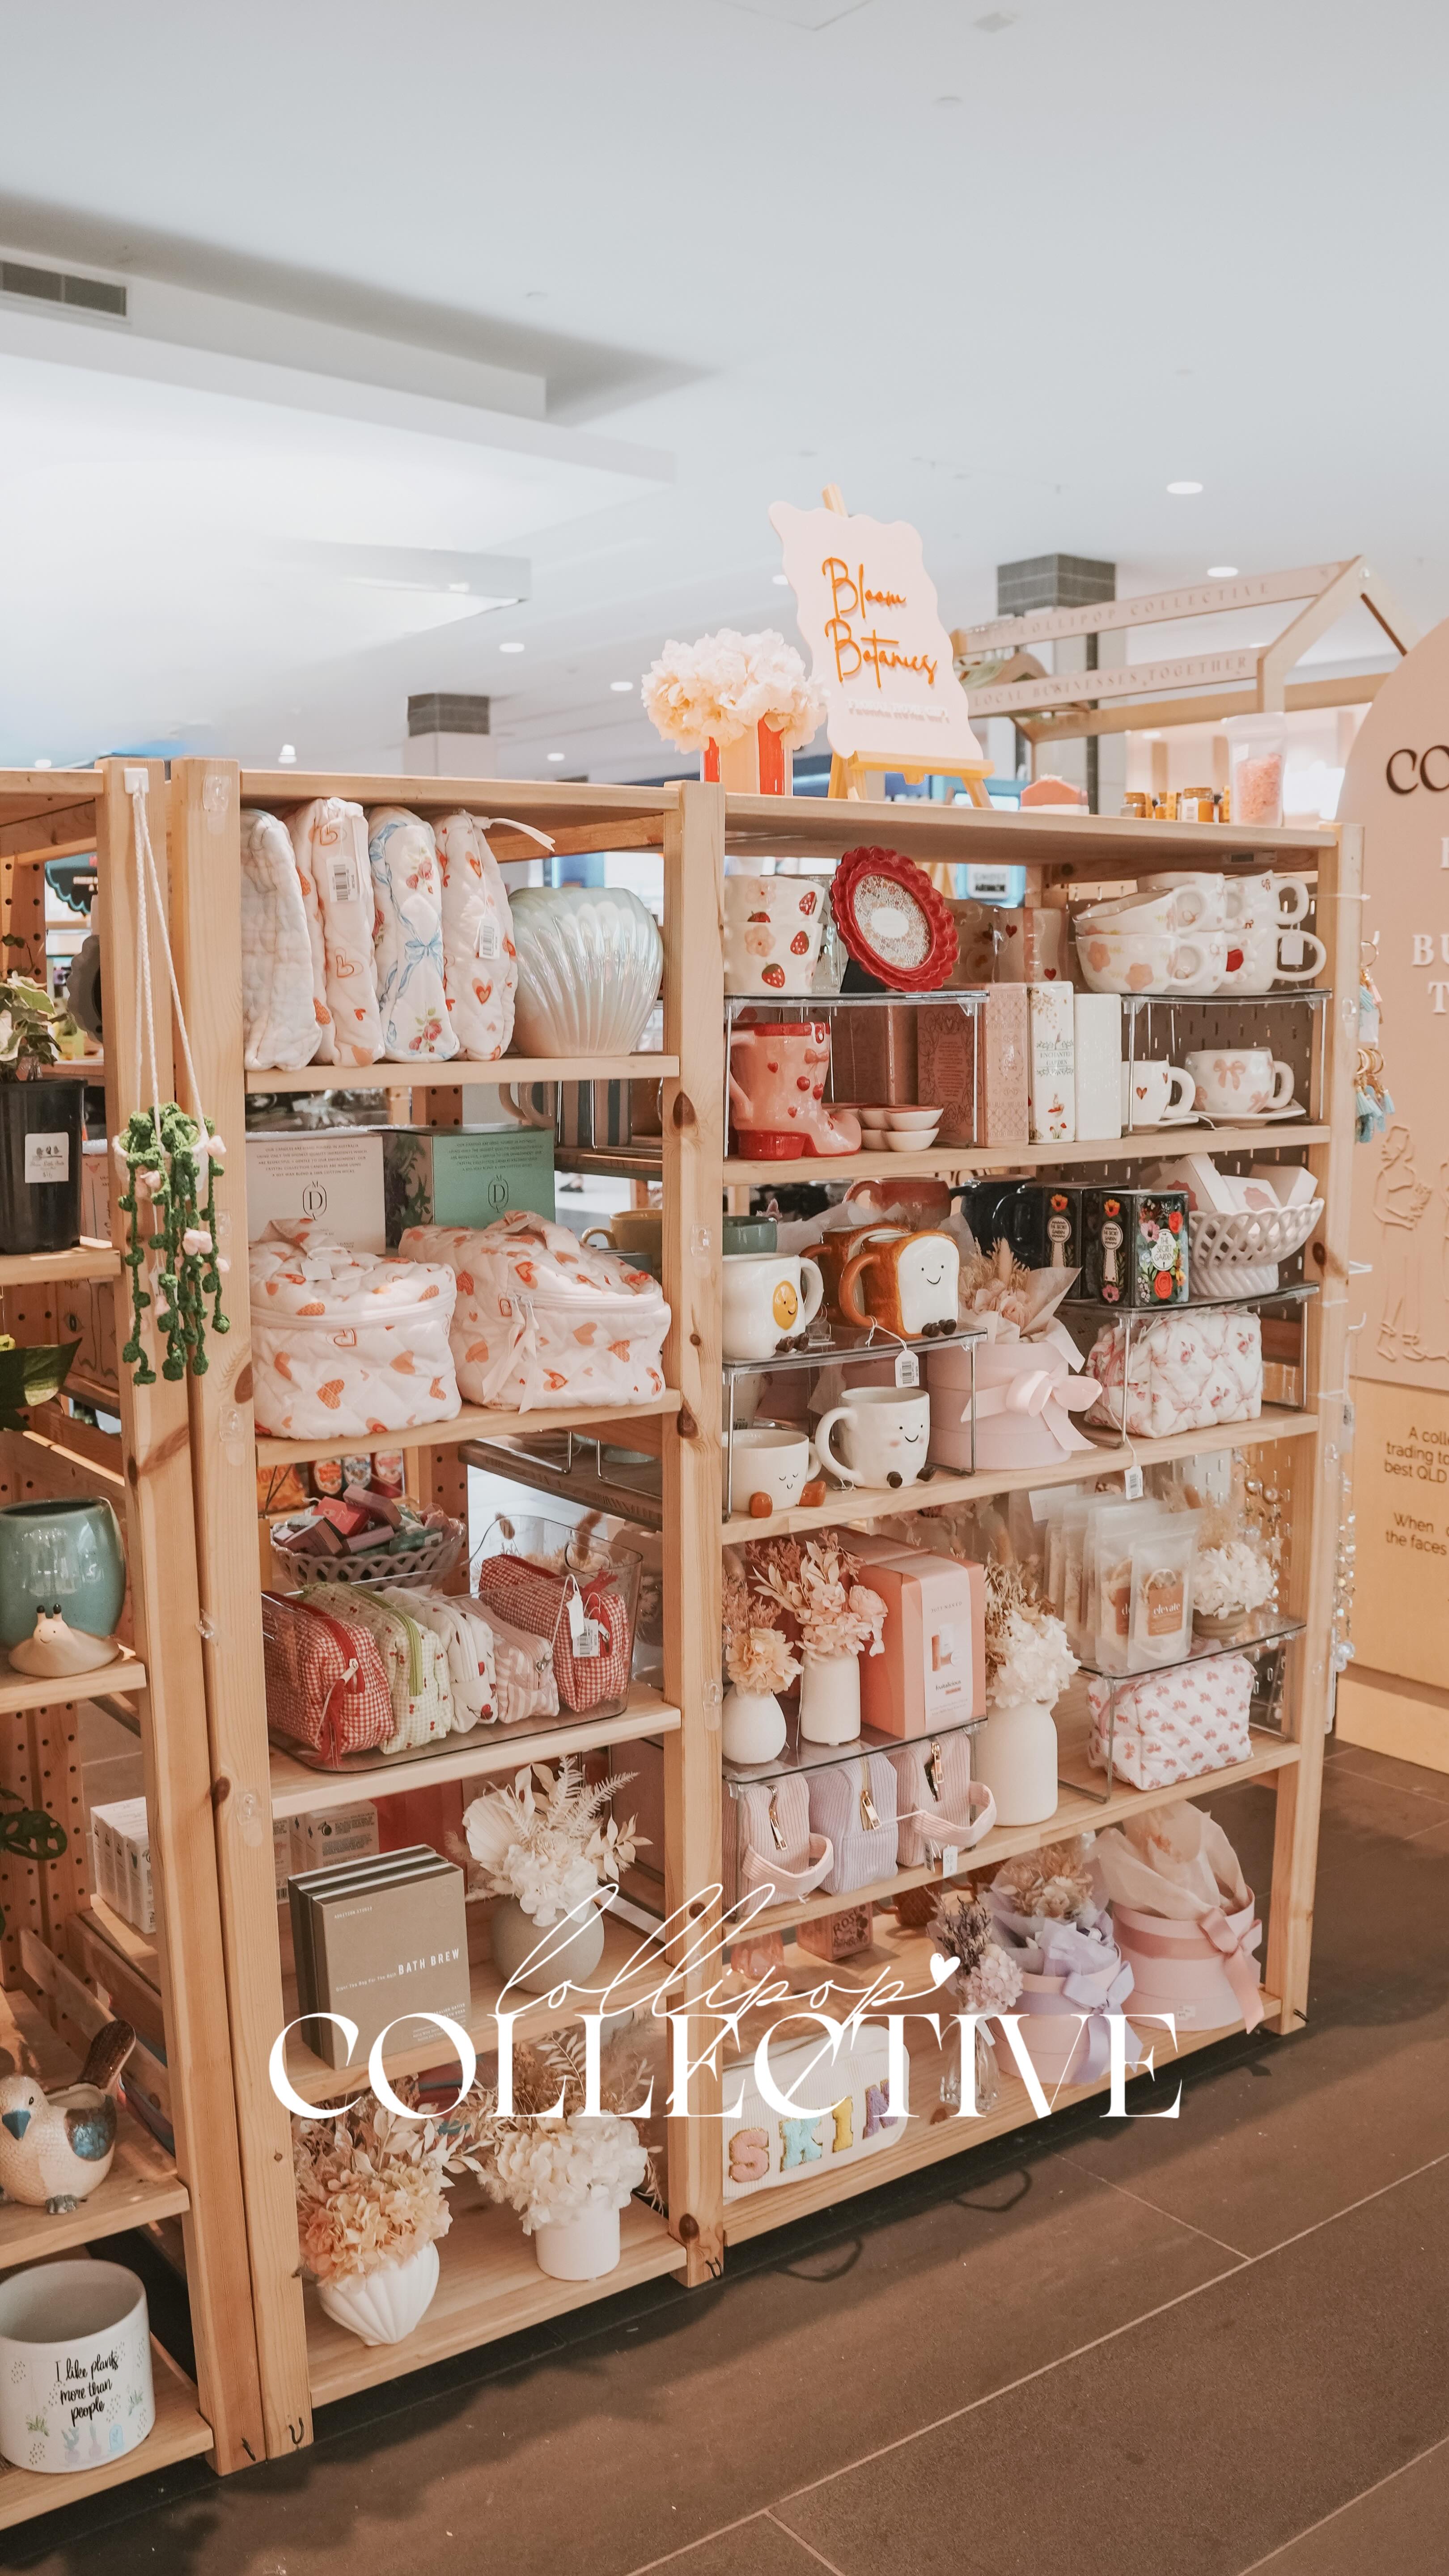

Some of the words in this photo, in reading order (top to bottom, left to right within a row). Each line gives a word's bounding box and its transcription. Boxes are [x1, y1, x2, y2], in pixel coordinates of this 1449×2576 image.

[822, 557, 907, 620] Bloom
[1020, 609, 1115, 635] LOLLIPOP
[1130, 582, 1269, 615] COLLECTIVE
[974, 692, 1023, 707] LOCAL
[1033, 673, 1137, 698] BUSINESSES
[1148, 657, 1247, 682] TOGETHER
[1157, 1244, 1172, 1253] SECRET
[1161, 1237, 1169, 1245] THE
[1154, 1253, 1174, 1261] GARDEN
[1408, 1426, 1419, 1440] A
[1386, 1441, 1434, 1465] trading
[1384, 1460, 1413, 1478] best
[1417, 1465, 1448, 1483] QLD
[1394, 1512, 1434, 1533] When
[1385, 1530, 1407, 1547] the
[1411, 1536, 1447, 1556] faces
[1153, 1602, 1181, 1615] elevate
[398, 1957, 425, 1975] BATH
[430, 1948, 459, 1967] BREW
[729, 2079, 898, 2183] SKIN
[55, 2360, 62, 2384] I
[66, 2357, 88, 2381] like
[91, 2349, 119, 2380] plants
[60, 2388, 86, 2405] more
[88, 2378, 112, 2397] than
[71, 2395, 105, 2428] people
